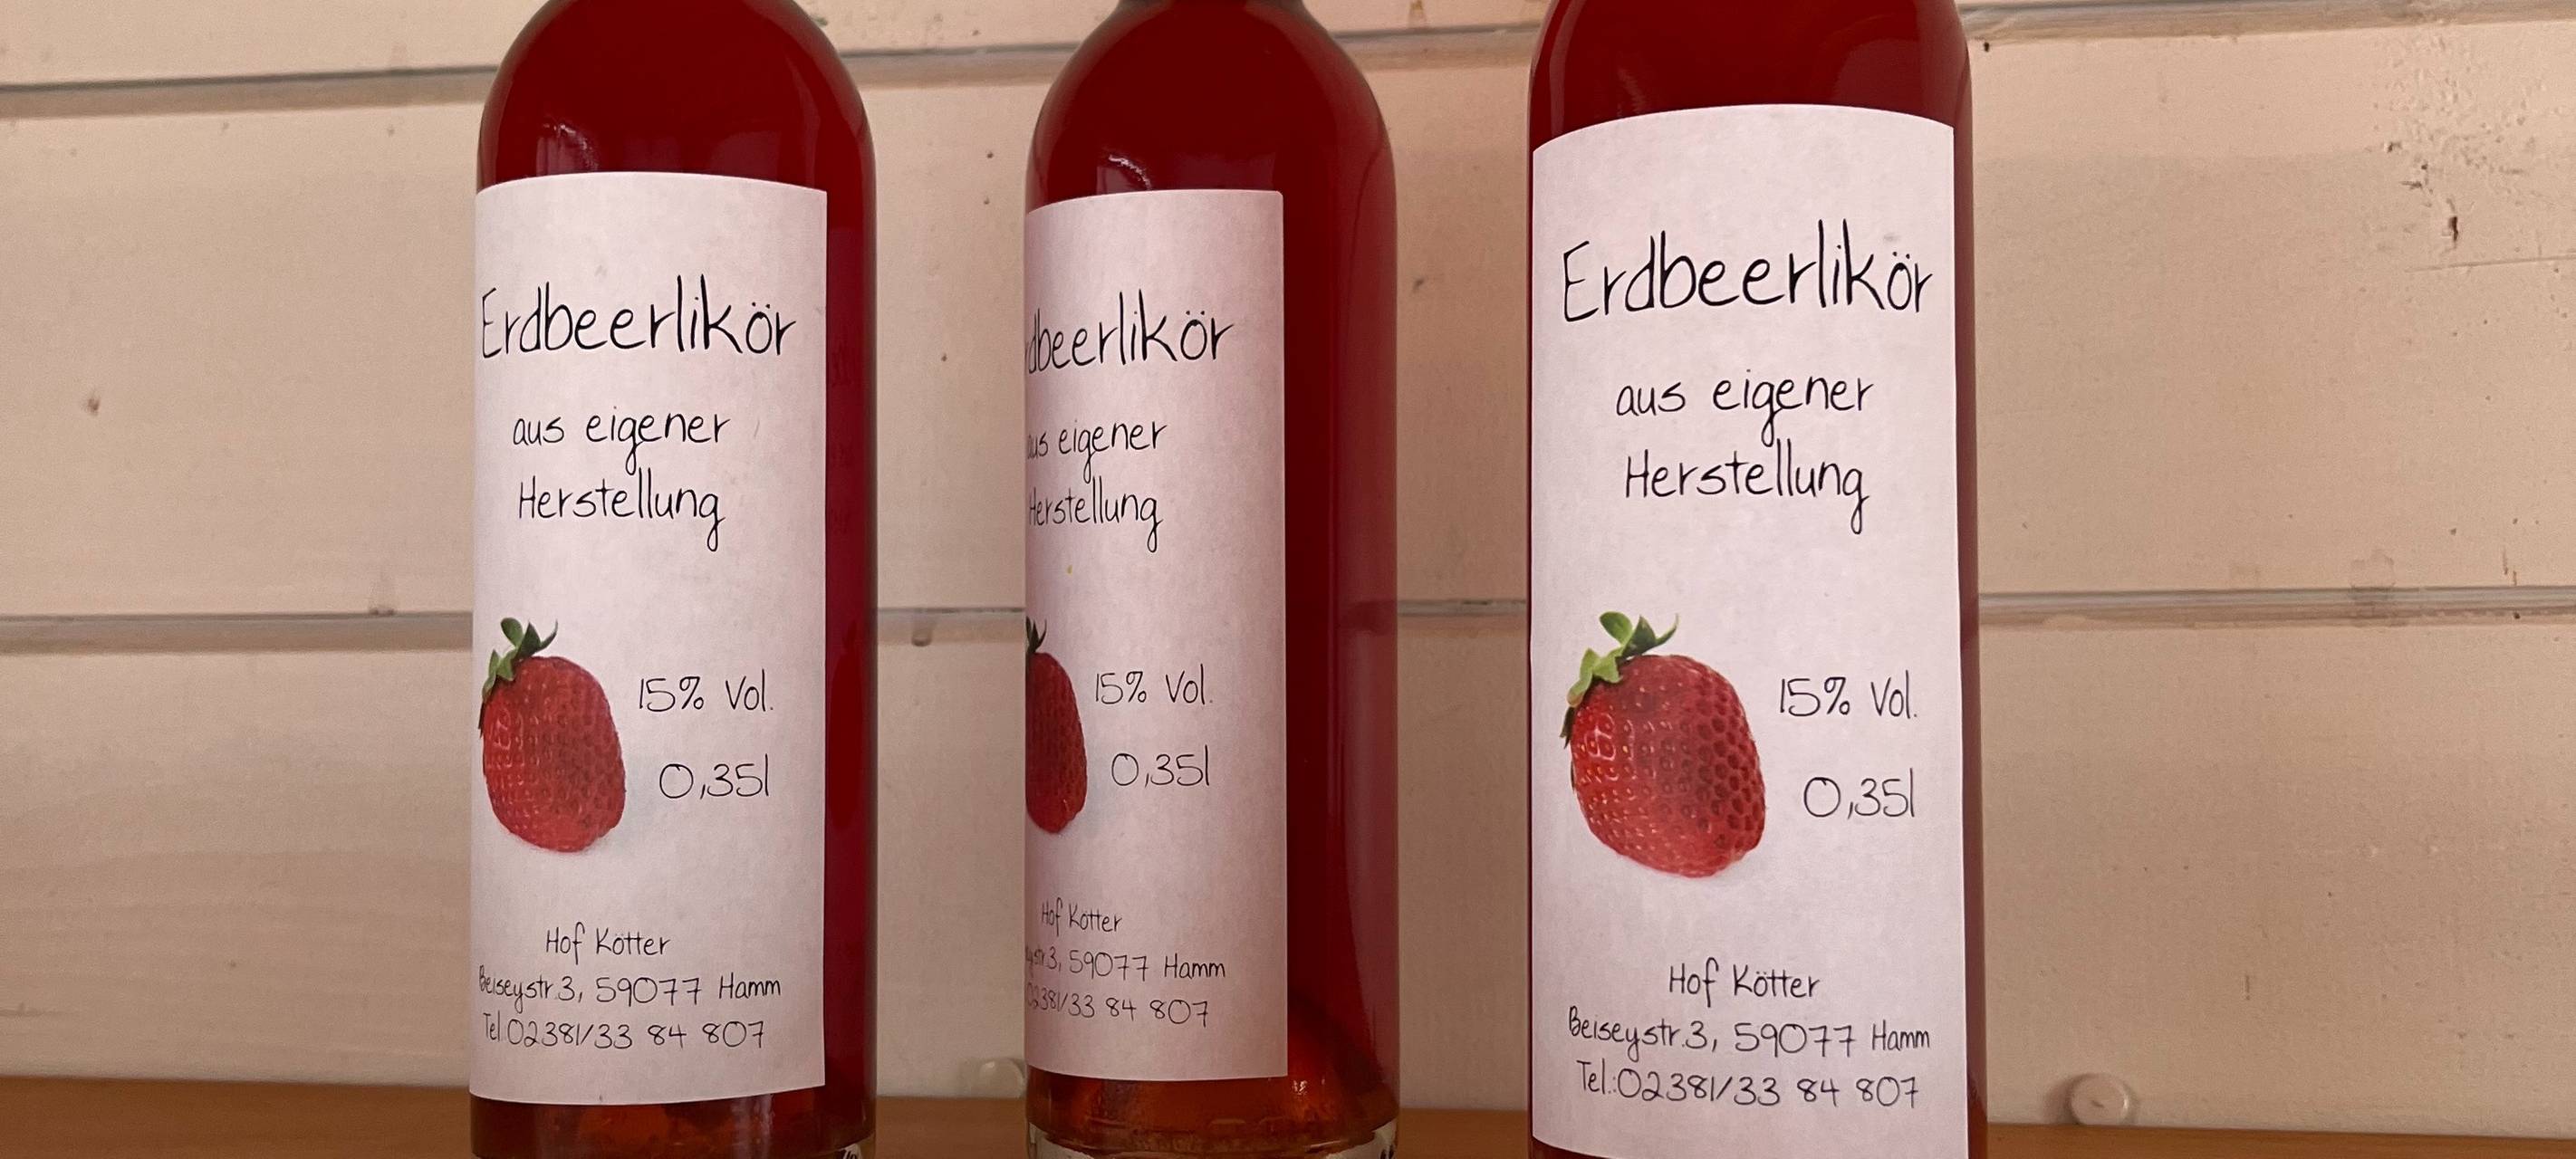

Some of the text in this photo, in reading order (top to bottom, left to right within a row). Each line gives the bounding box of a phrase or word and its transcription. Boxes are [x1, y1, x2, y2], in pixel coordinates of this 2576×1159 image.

[1563, 218, 1933, 322] Erdbeerlikör
[482, 273, 796, 359] Erdbeerlikör
[1025, 288, 1234, 373] dbeerlikör
[1616, 369, 1874, 447] aus eigener
[513, 406, 731, 475] aus eigener
[1058, 419, 1168, 484] eigener
[519, 467, 726, 552] Herstellung
[1625, 438, 1870, 535] Herstellung
[1028, 475, 1163, 553] Herstellung
[639, 668, 774, 712] 15% Vol.
[1096, 663, 1213, 704] 15% Vol.
[1780, 670, 1918, 719] 15% Vol.
[659, 753, 769, 800] 0,35l
[1111, 744, 1209, 788] 0,35l
[1803, 768, 1915, 819] 0,35l
[1042, 897, 1062, 936] Hof
[546, 922, 670, 965] Hof Kötter
[1070, 950, 1149, 982] 59077
[1165, 953, 1226, 979] Hamm
[596, 977, 702, 1007] 59077
[719, 972, 781, 999] Hamm
[1669, 957, 1821, 1008] Hof Kötter
[648, 1024, 687, 1049] 84
[702, 1020, 764, 1049] 807
[1106, 998, 1137, 1021] 84
[1149, 1000, 1208, 1028] 807
[1735, 1022, 1856, 1058] 59077
[1871, 1020, 1930, 1051] Hamm
[1797, 1078, 1841, 1106] 84
[1856, 1077, 1918, 1108] 807
